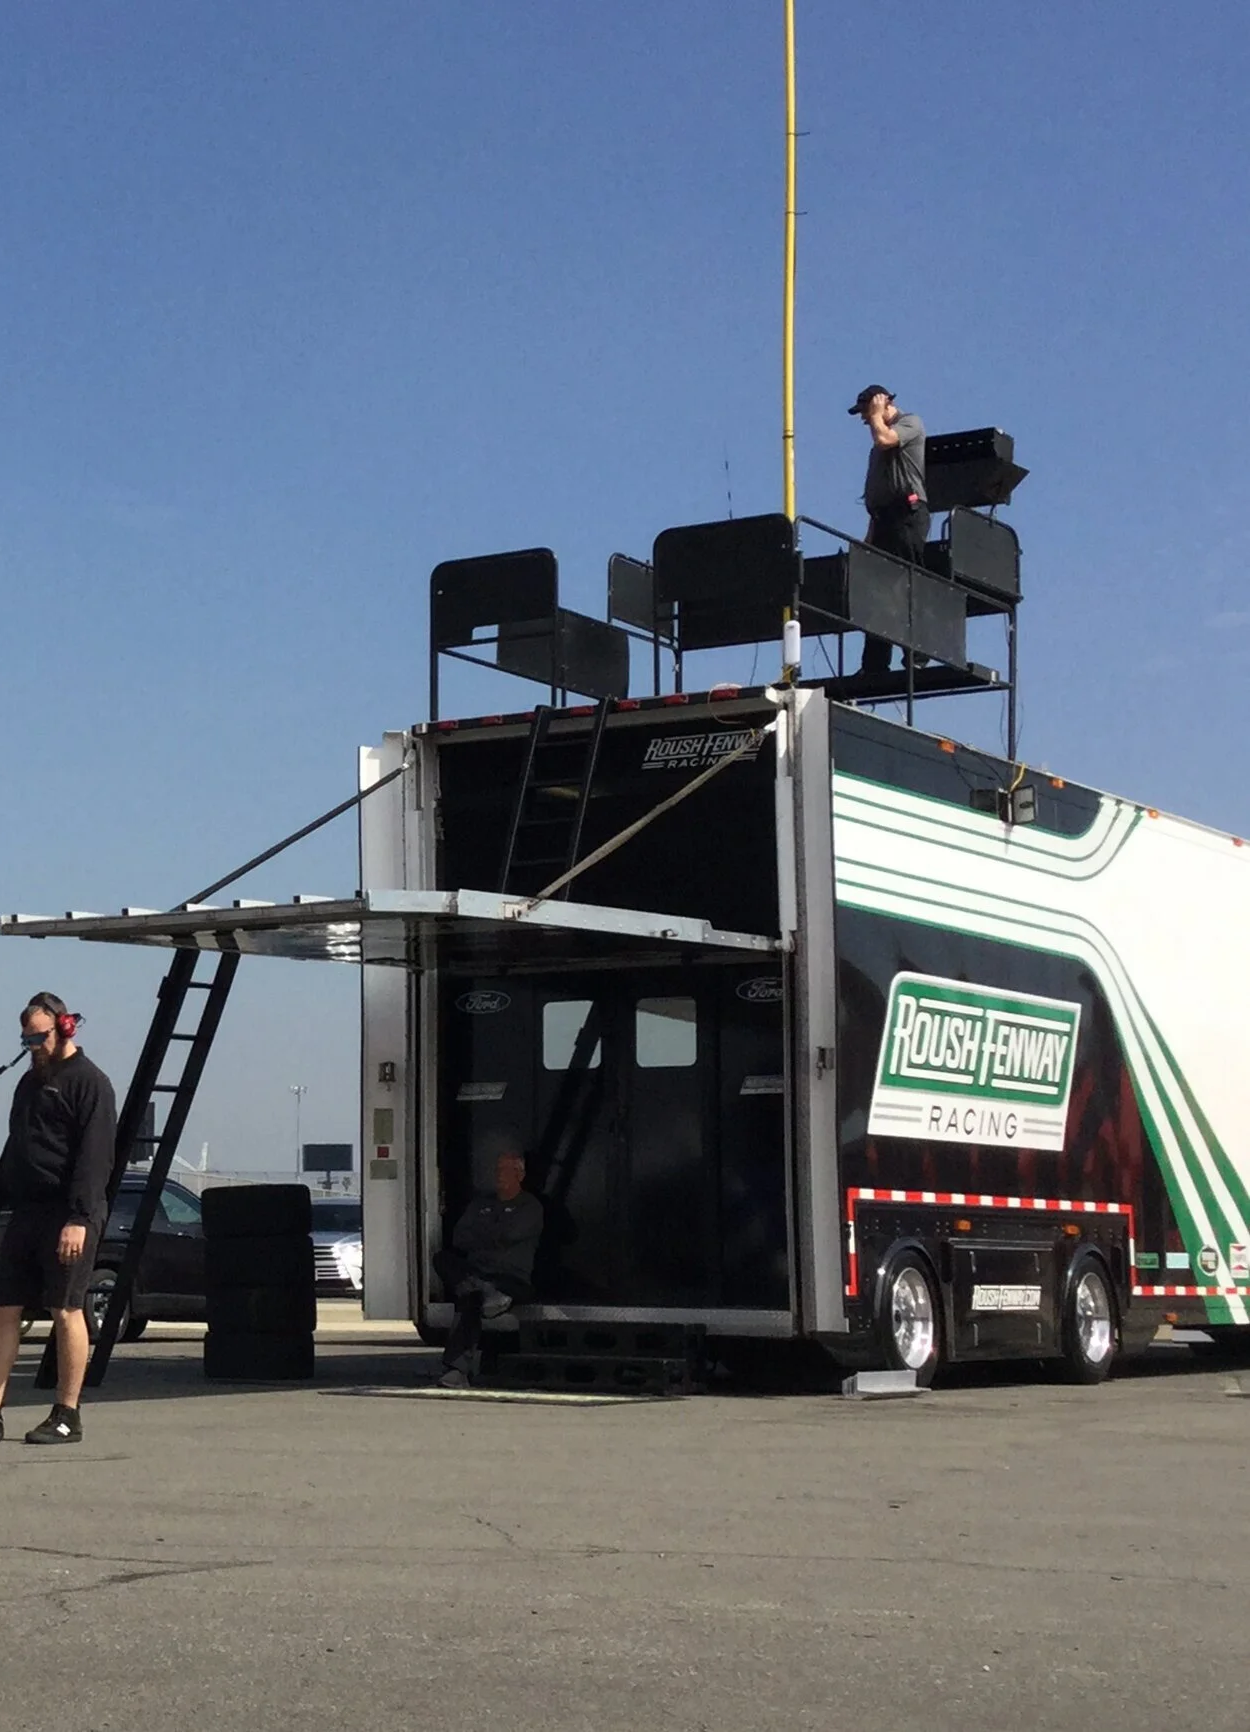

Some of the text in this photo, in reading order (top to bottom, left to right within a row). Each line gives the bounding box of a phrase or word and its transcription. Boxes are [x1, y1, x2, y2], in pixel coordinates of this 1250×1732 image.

[645, 729, 766, 761] ROUSH FENWY
[889, 994, 1071, 1094] ROUSH FENWAY
[928, 1105, 1018, 1139] RACING
